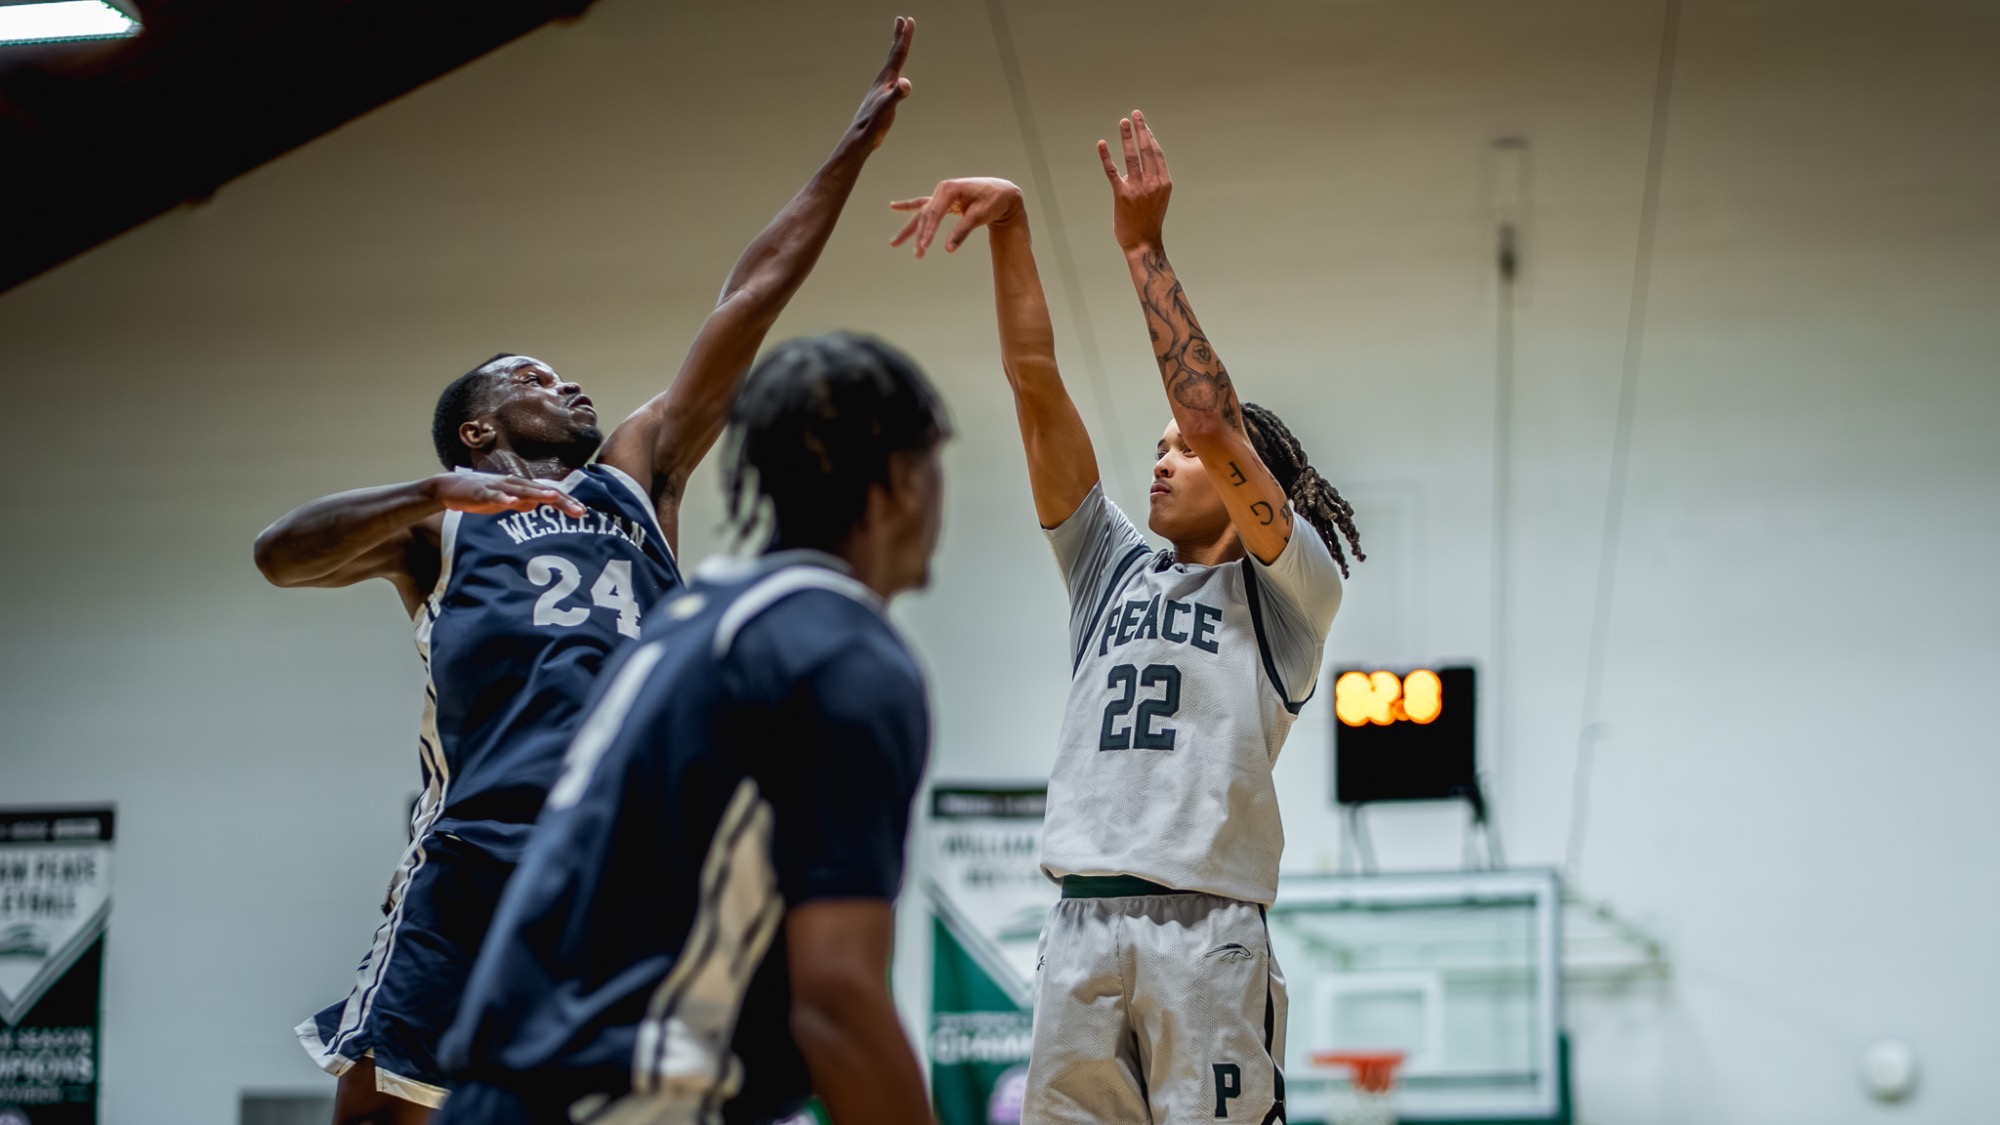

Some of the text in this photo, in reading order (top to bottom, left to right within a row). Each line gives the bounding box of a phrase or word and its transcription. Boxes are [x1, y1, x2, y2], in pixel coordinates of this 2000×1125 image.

[526, 554, 642, 641] 24
[1098, 592, 1223, 658] PEACE
[1099, 663, 1182, 752] 22
[1212, 1063, 1241, 1118] P
